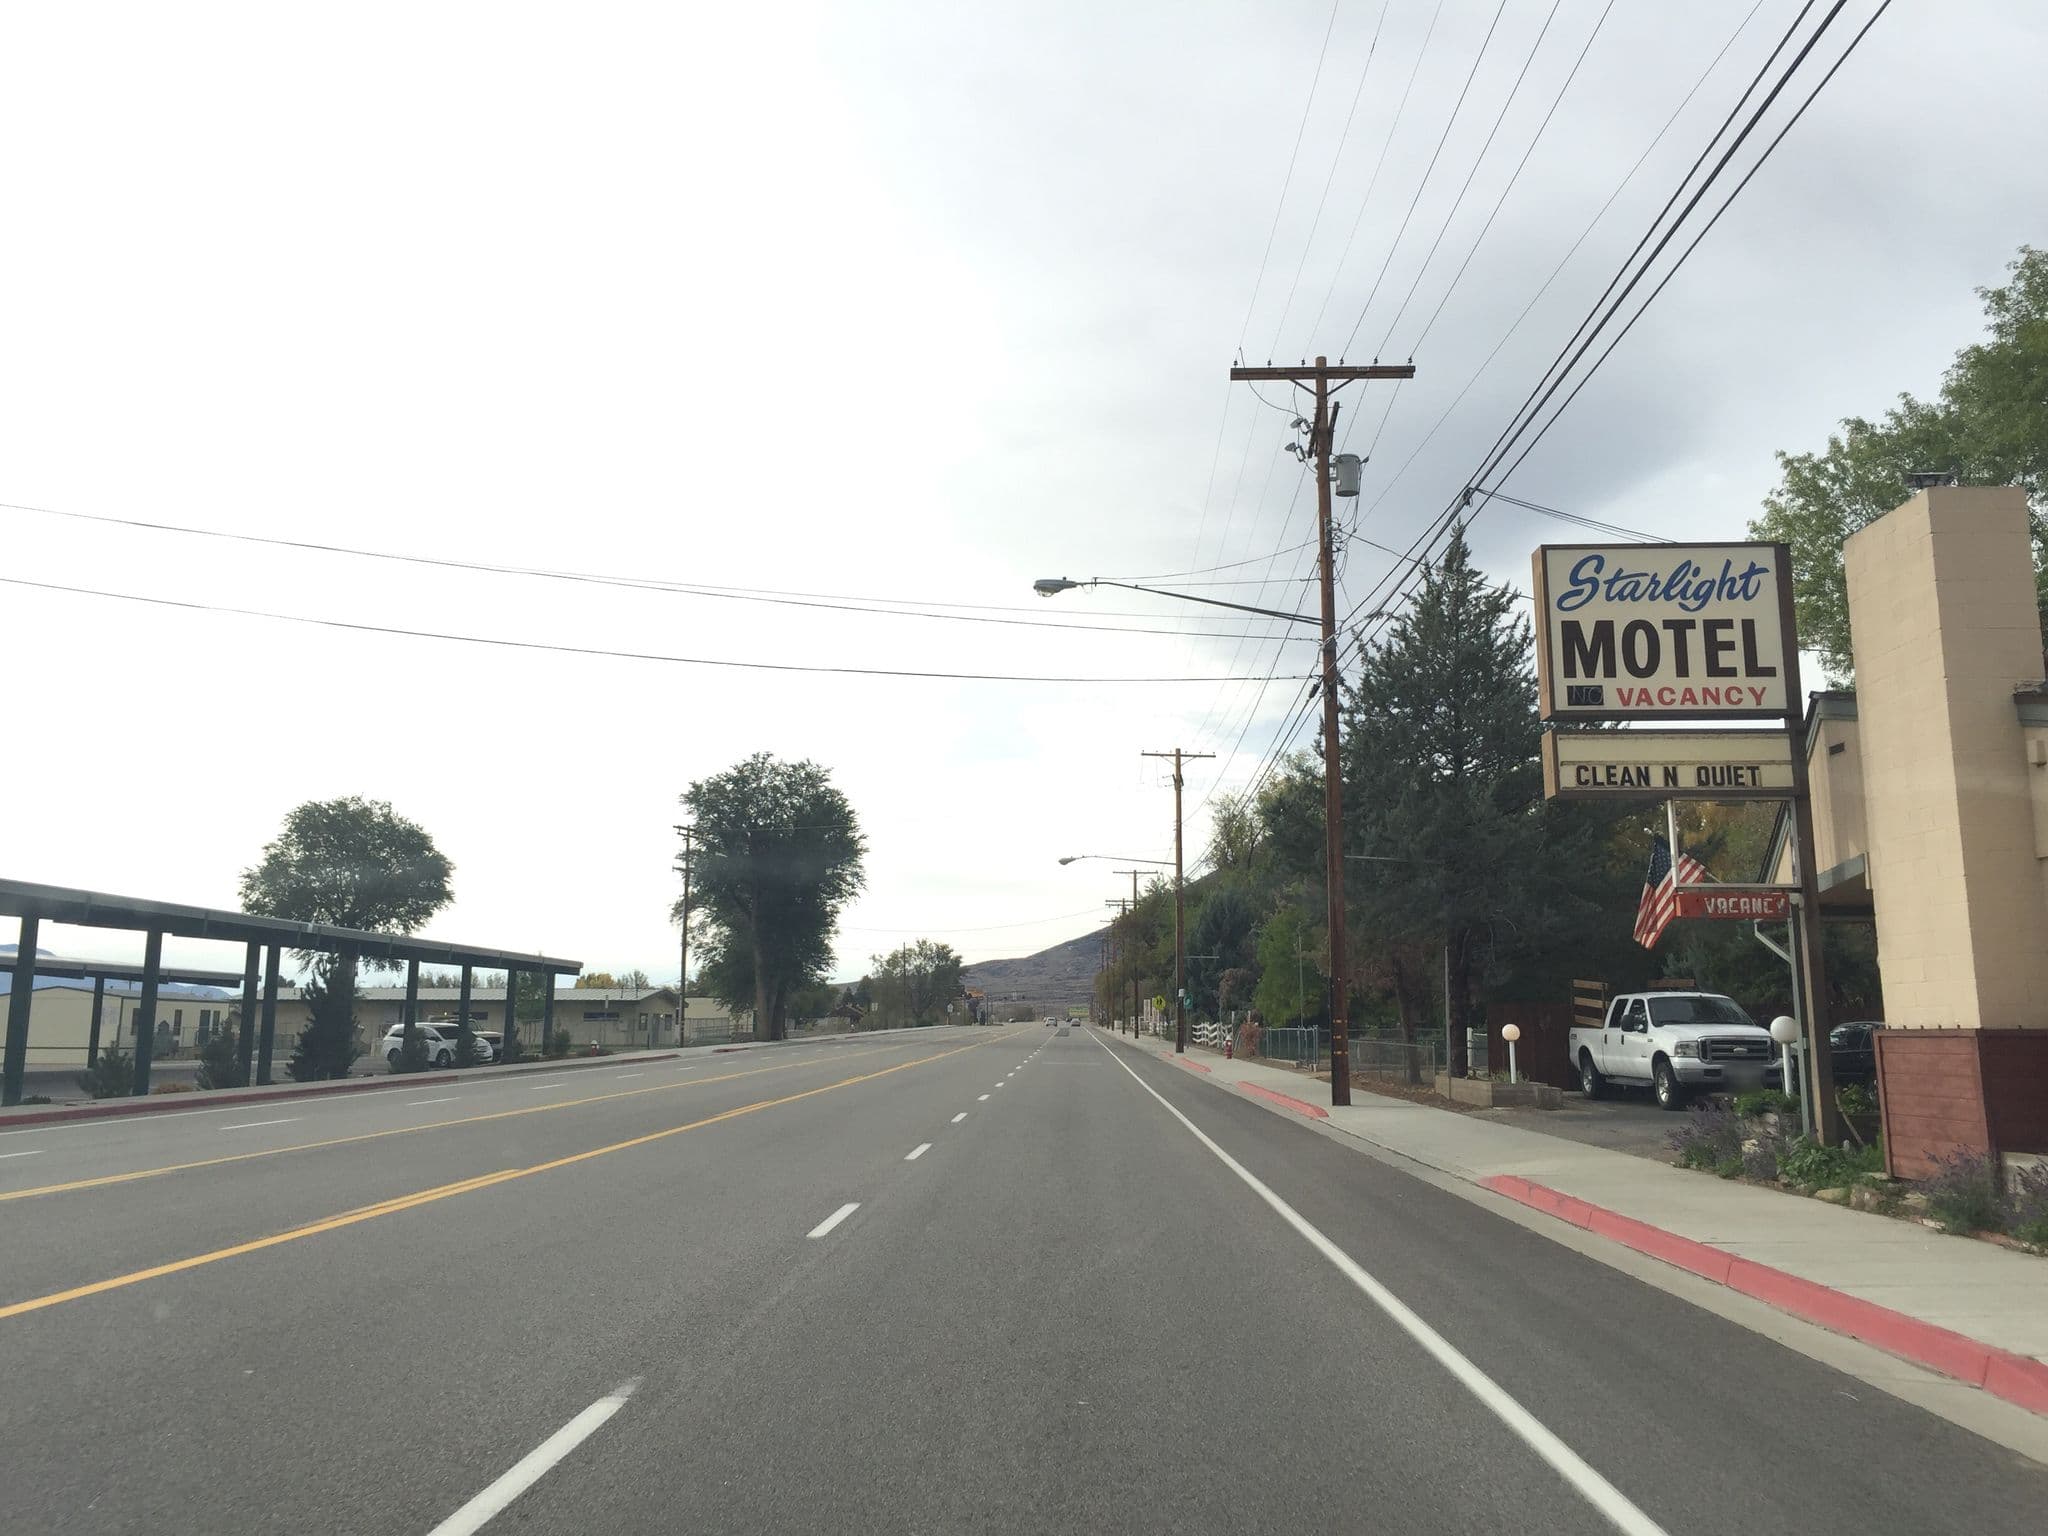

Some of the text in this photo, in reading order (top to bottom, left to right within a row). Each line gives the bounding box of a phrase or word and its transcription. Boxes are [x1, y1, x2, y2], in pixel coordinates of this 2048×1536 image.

[1556, 554, 1770, 613] Starlight
[1561, 618, 1777, 679] MOTEL
[1616, 686, 1767, 707] VACANCY
[1575, 764, 1760, 787] CLEAN N QUIET
